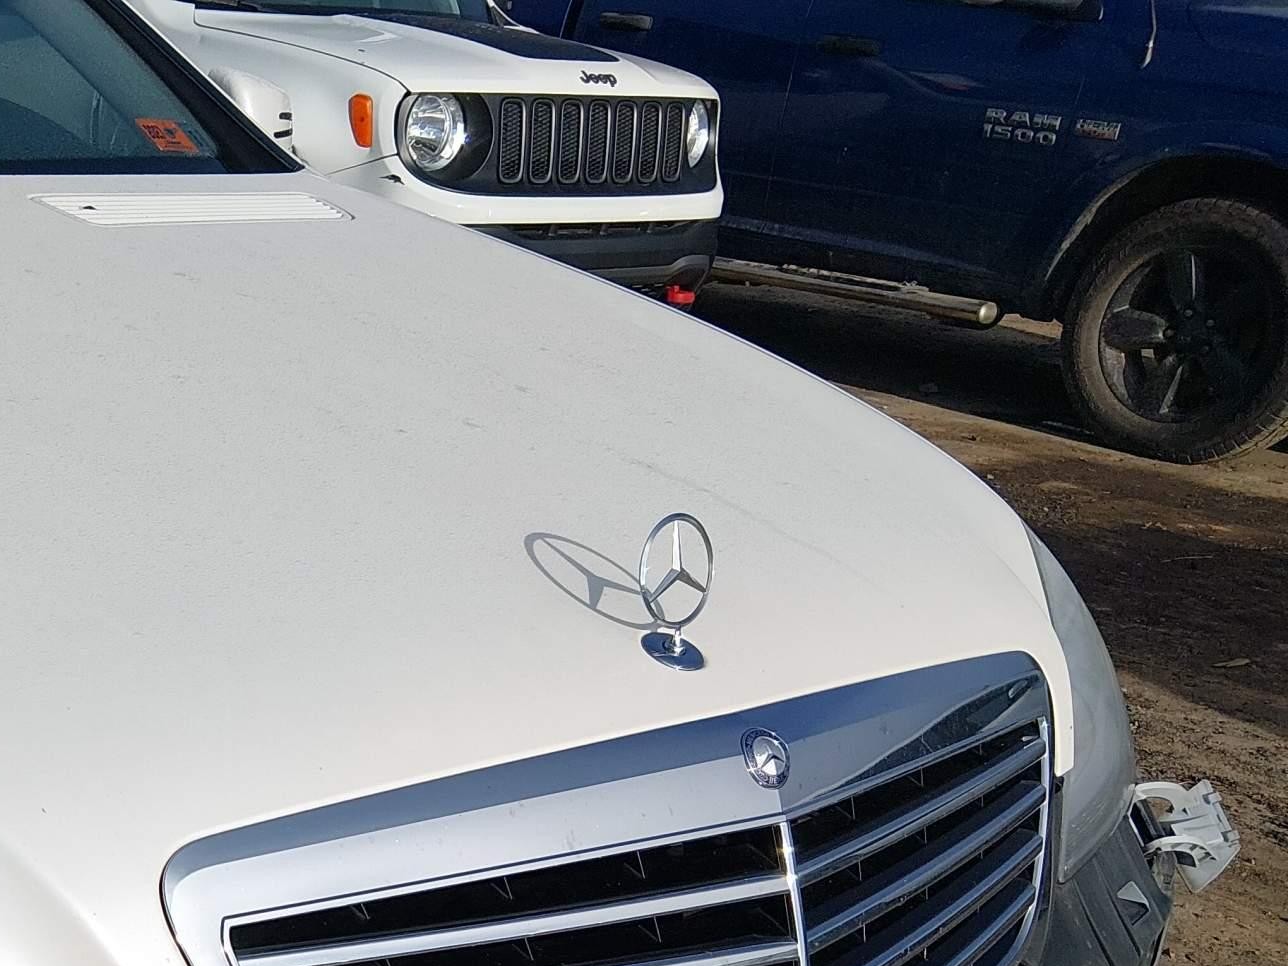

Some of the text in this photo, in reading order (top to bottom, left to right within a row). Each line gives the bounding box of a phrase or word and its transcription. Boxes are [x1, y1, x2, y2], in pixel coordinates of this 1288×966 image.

[579, 70, 617, 87] Jeep
[984, 107, 1062, 131] RAM
[983, 122, 1057, 145] 1500
